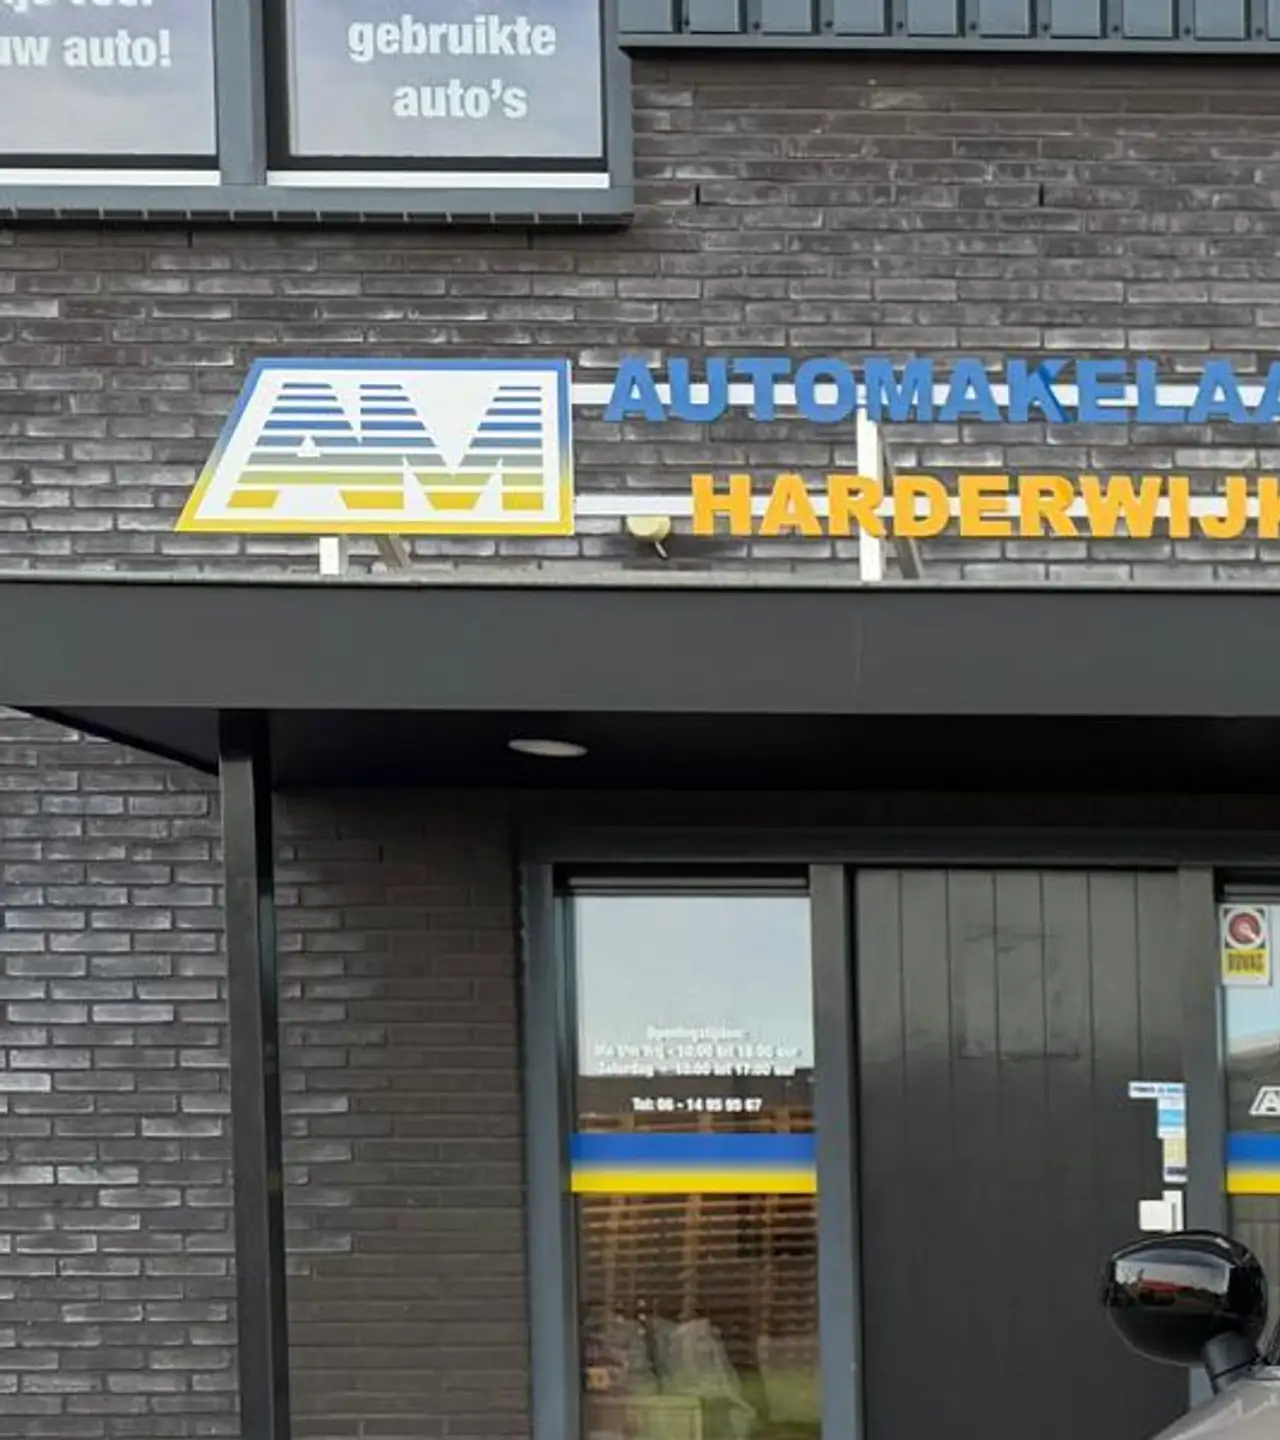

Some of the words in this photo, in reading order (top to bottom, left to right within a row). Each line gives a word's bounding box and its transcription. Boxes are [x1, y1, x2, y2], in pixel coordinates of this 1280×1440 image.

[63, 29, 171, 67] auto!
[348, 14, 556, 62] gebruikte
[392, 78, 528, 119] auto's
